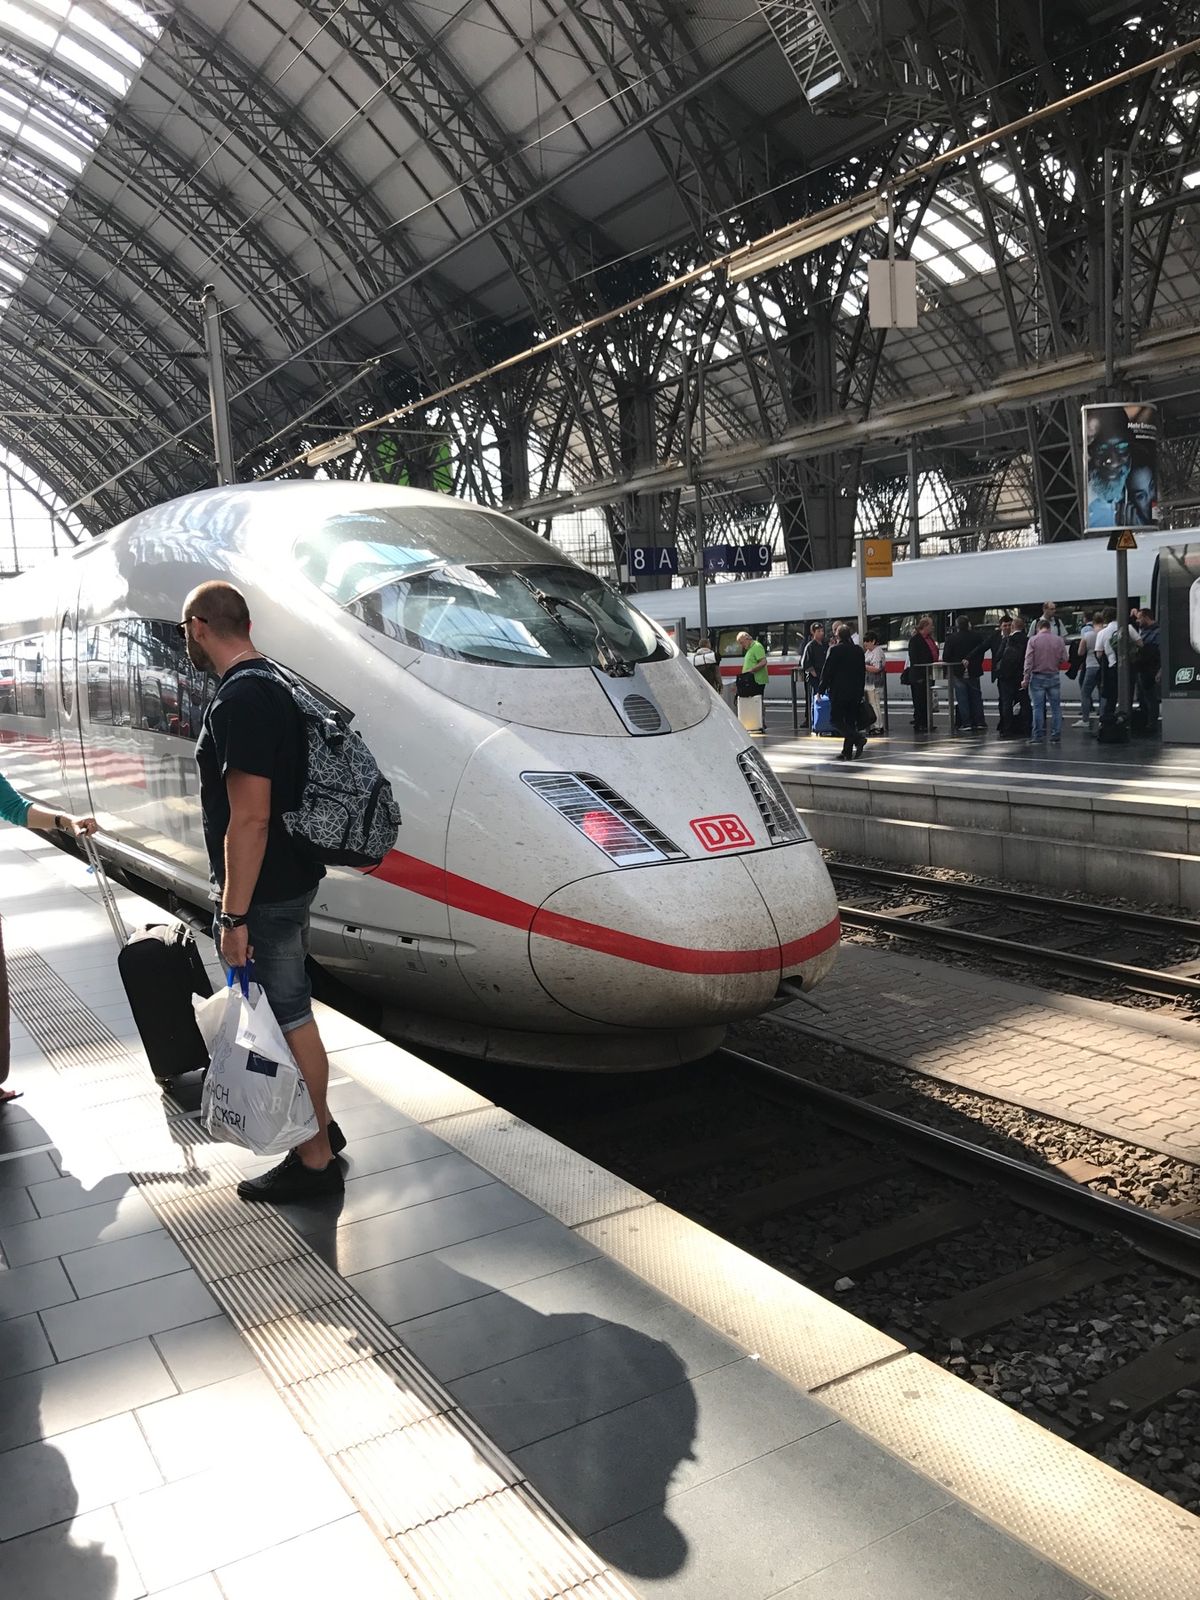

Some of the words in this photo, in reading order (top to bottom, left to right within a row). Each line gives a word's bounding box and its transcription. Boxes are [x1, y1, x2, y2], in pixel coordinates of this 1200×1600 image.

[634, 548, 645, 570] 8
[658, 548, 672, 569] A
[733, 547, 747, 567] A
[758, 546, 769, 566] 9
[697, 819, 747, 846] DB
[213, 1105, 246, 1131] CKER!
